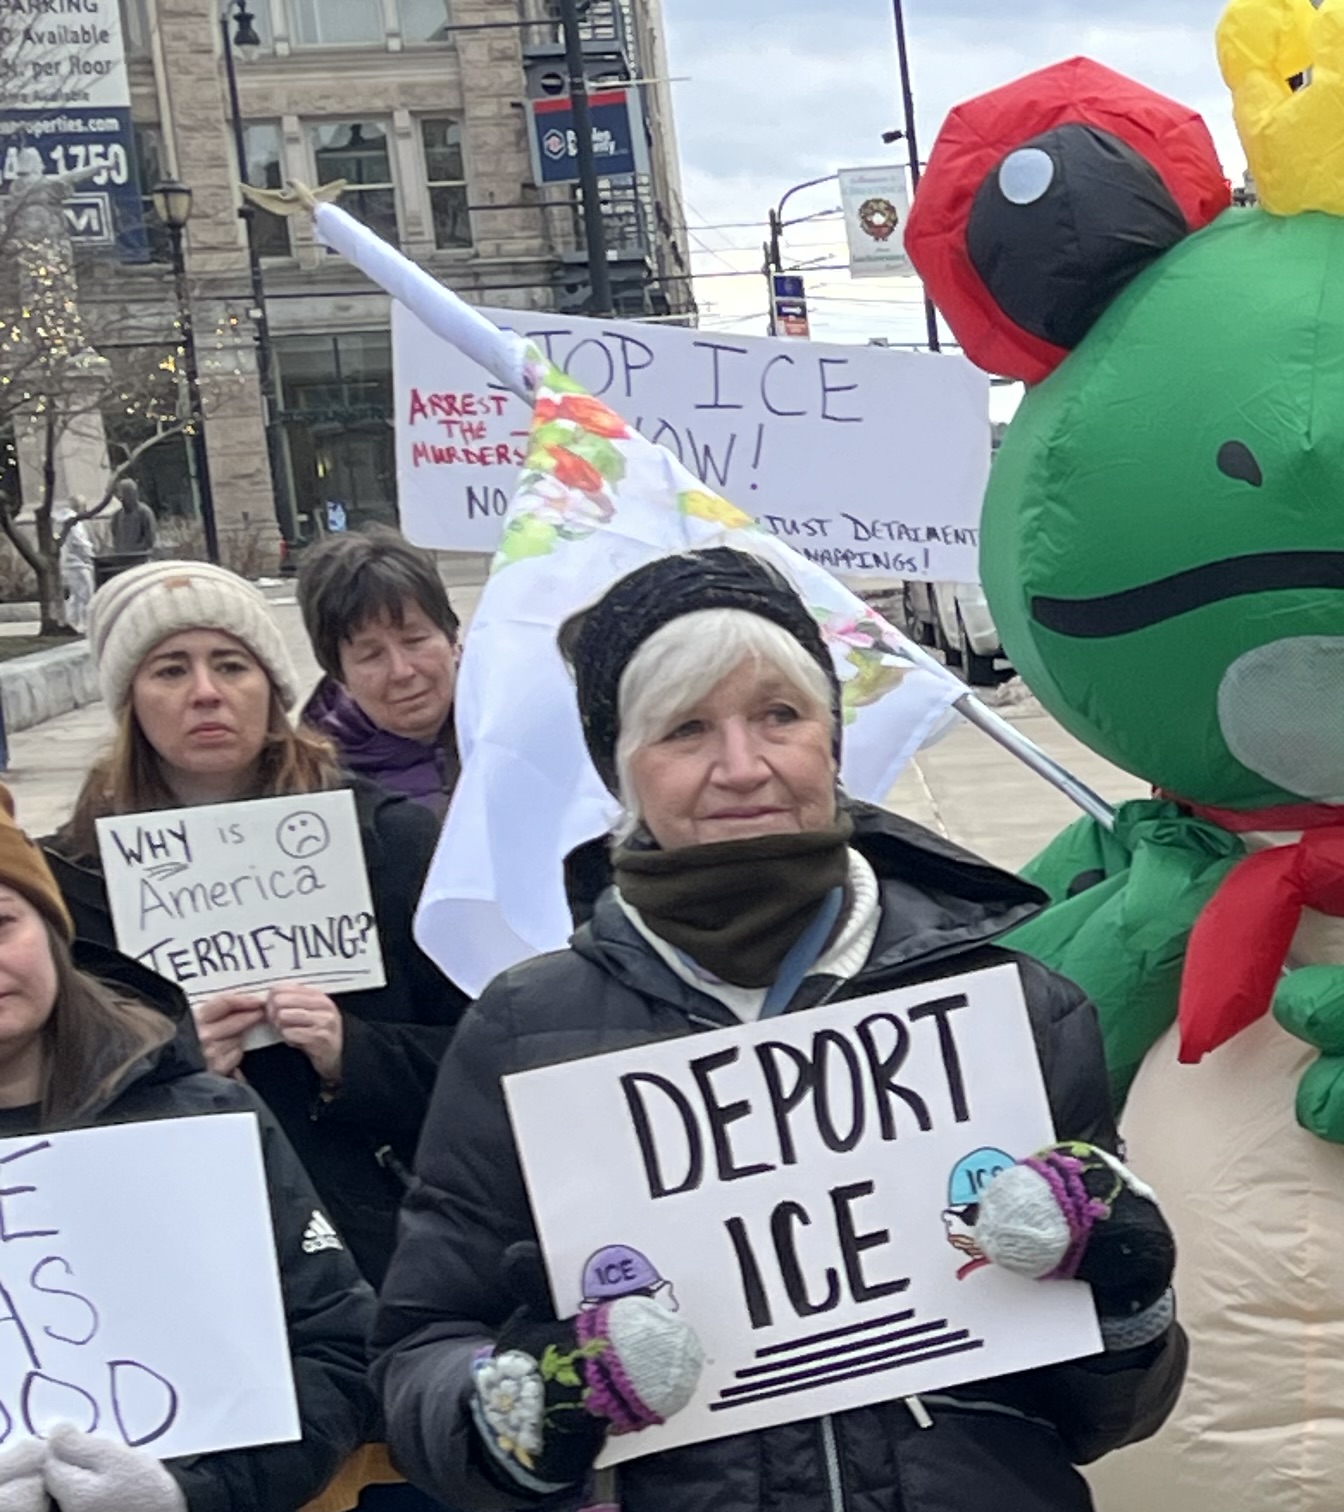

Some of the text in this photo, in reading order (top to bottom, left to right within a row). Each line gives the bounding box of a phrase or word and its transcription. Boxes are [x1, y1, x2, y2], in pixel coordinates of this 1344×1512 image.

[23, 24, 110, 45] Available
[487, 326, 863, 422] TOP ICE
[408, 388, 508, 425] ARREST
[437, 419, 487, 440] THE
[763, 514, 832, 537] JUST
[110, 820, 193, 867] WHY
[139, 865, 327, 931] America
[135, 911, 376, 982] TERRIFYING?
[620, 993, 970, 1199] DEPORT
[965, 1164, 1004, 1195] IC
[595, 1258, 637, 1286] ICE
[724, 1180, 911, 1329] ICE
[0, 1360, 178, 1447] OD
